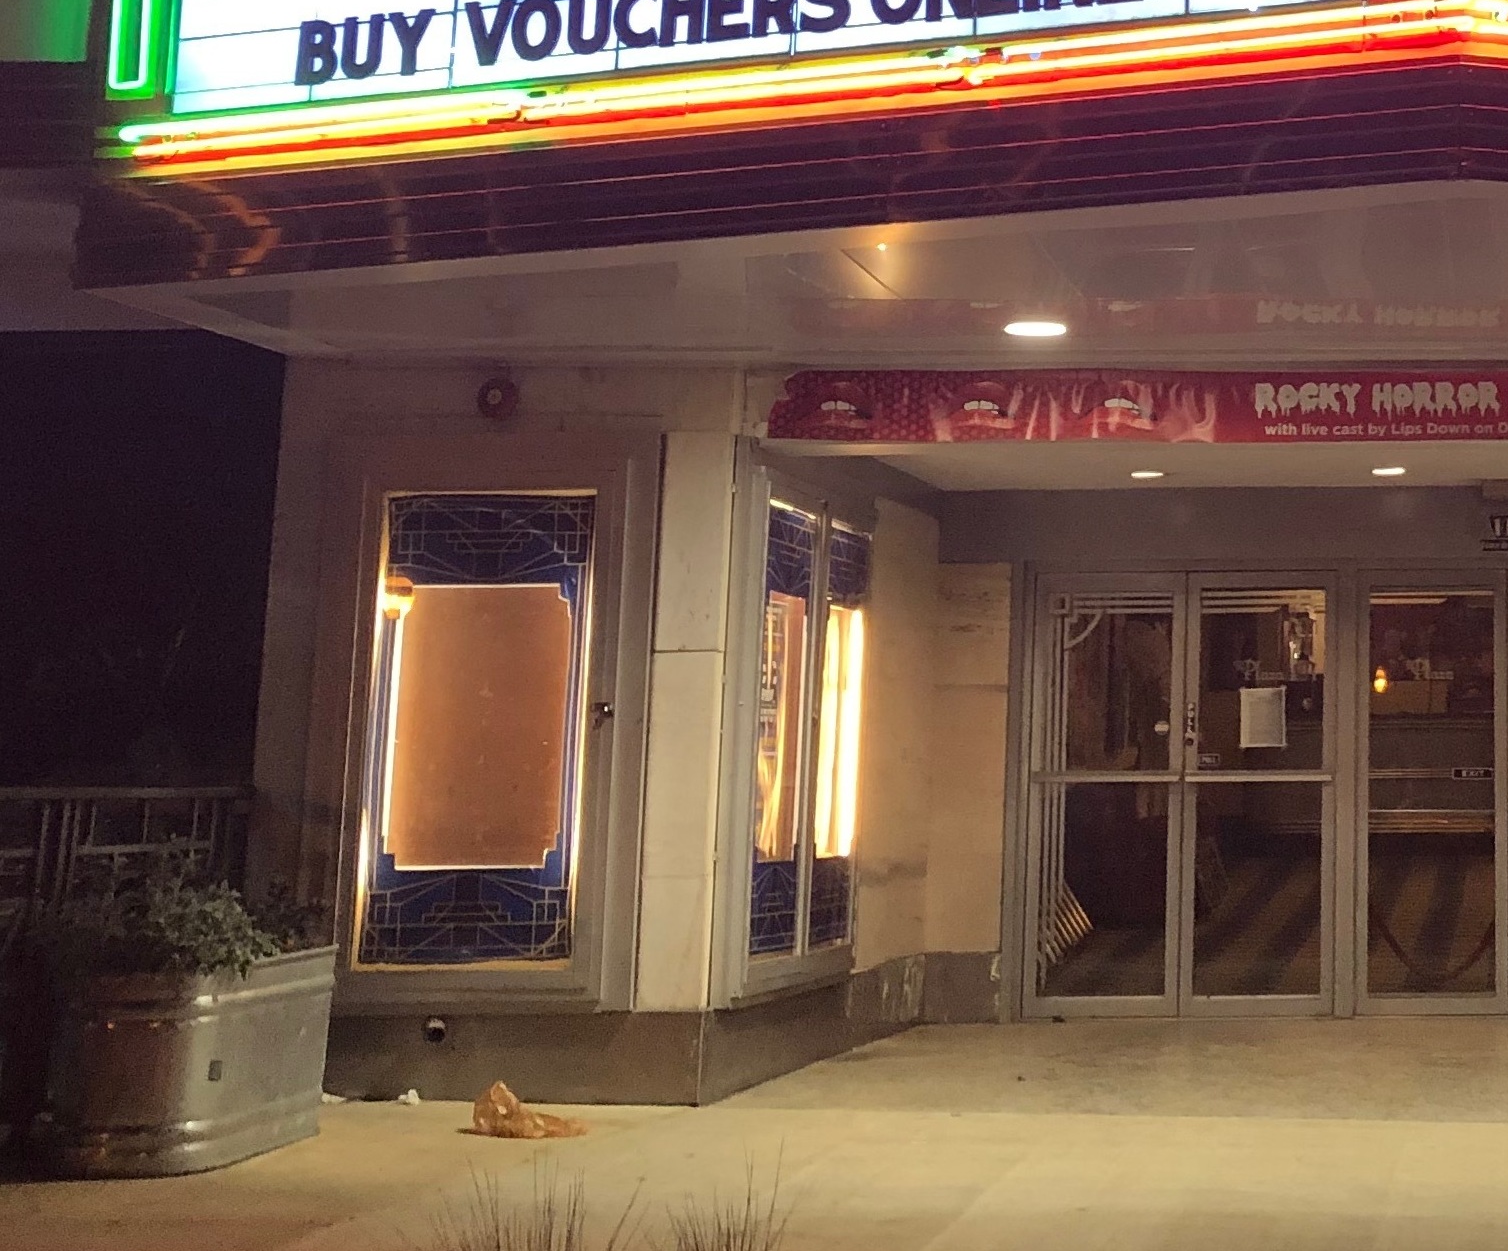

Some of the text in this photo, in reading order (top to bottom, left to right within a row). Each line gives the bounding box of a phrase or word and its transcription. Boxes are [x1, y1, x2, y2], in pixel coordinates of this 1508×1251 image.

[294, 7, 436, 86] BUY
[1254, 382, 1362, 418] ROCKY
[1371, 381, 1500, 420] HORROR
[1264, 422, 1298, 436] with
[1301, 422, 1328, 435] live
[1332, 423, 1364, 436] cast
[1368, 422, 1387, 437] by
[1391, 422, 1423, 437] Lips
[1426, 422, 1470, 435] Down
[1473, 424, 1494, 435] on
